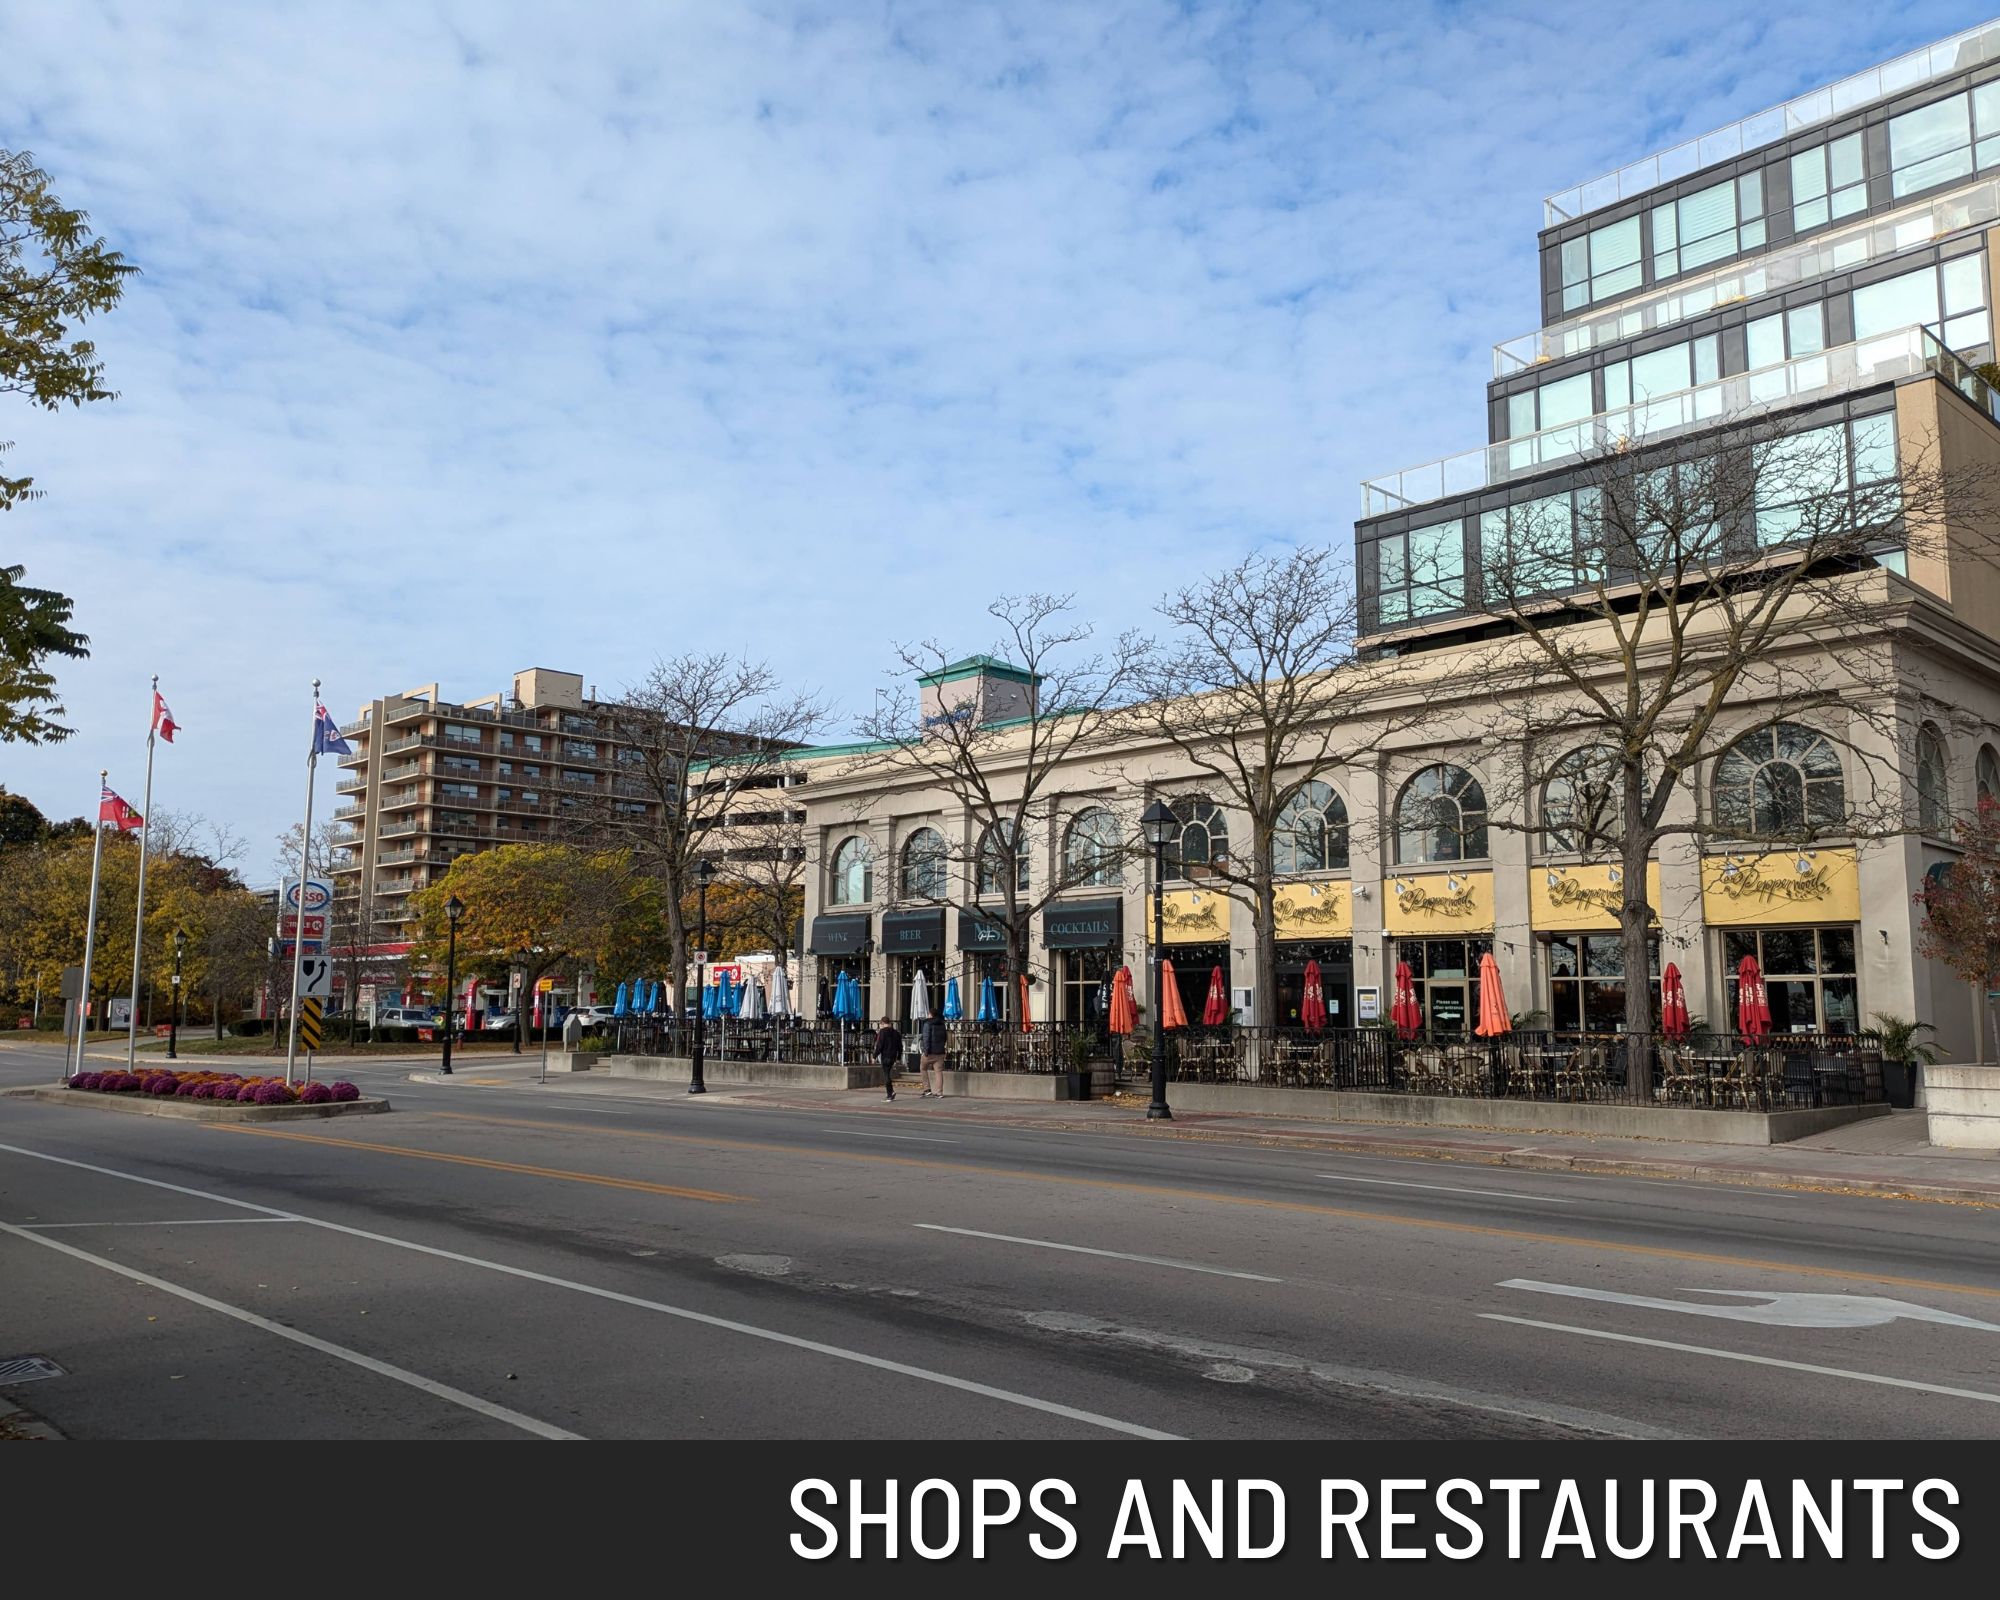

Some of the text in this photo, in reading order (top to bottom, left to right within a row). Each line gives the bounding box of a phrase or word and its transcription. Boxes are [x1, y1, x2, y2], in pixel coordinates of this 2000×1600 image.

[1723, 865, 1831, 903] Pepperwood
[1398, 885, 1476, 917] Pepperwood
[900, 929, 921, 940] BEER
[1050, 920, 1109, 935] COCKTAILS
